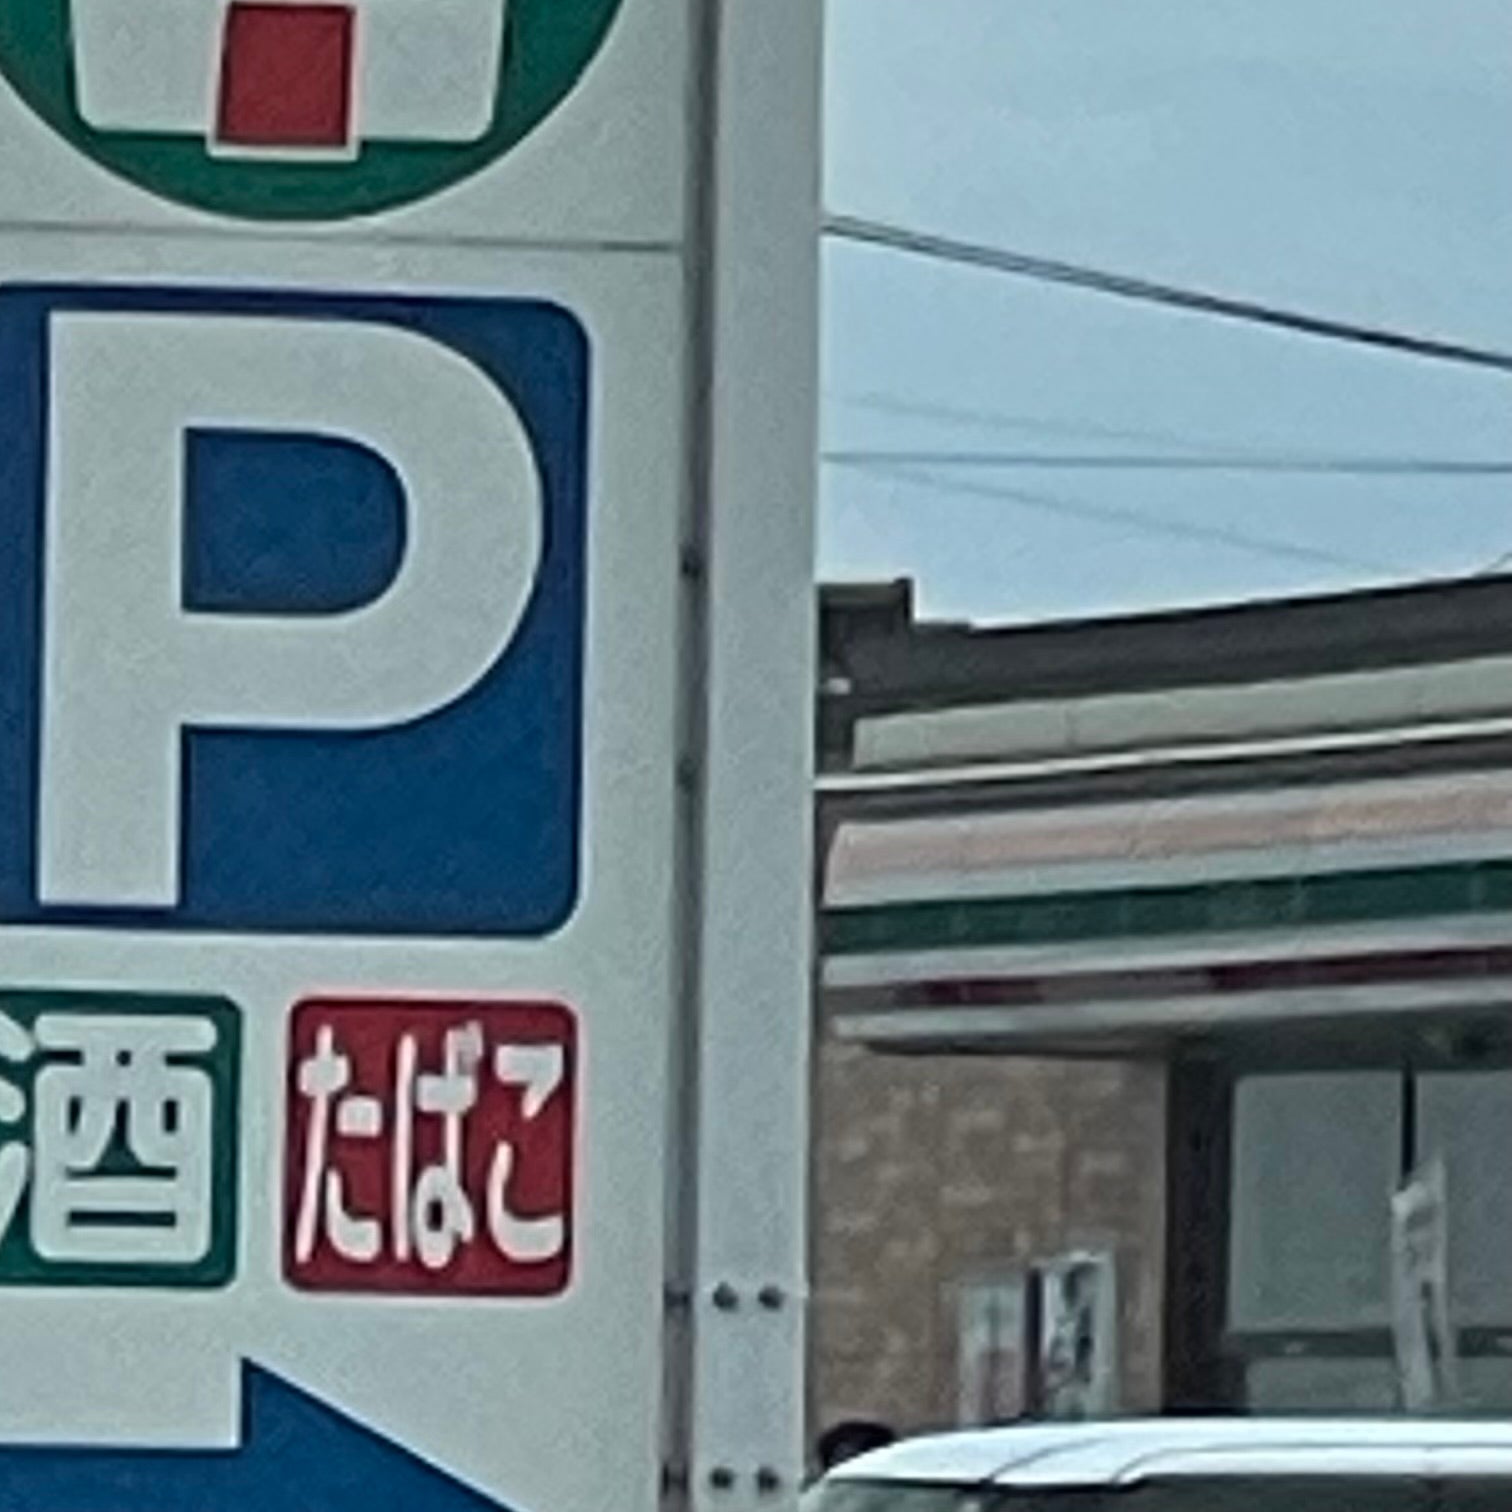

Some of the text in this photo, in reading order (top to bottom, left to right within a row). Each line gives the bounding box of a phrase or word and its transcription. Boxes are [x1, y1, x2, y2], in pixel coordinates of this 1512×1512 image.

[38, 310, 544, 907] P
[295, 1020, 564, 1269] たばこ
